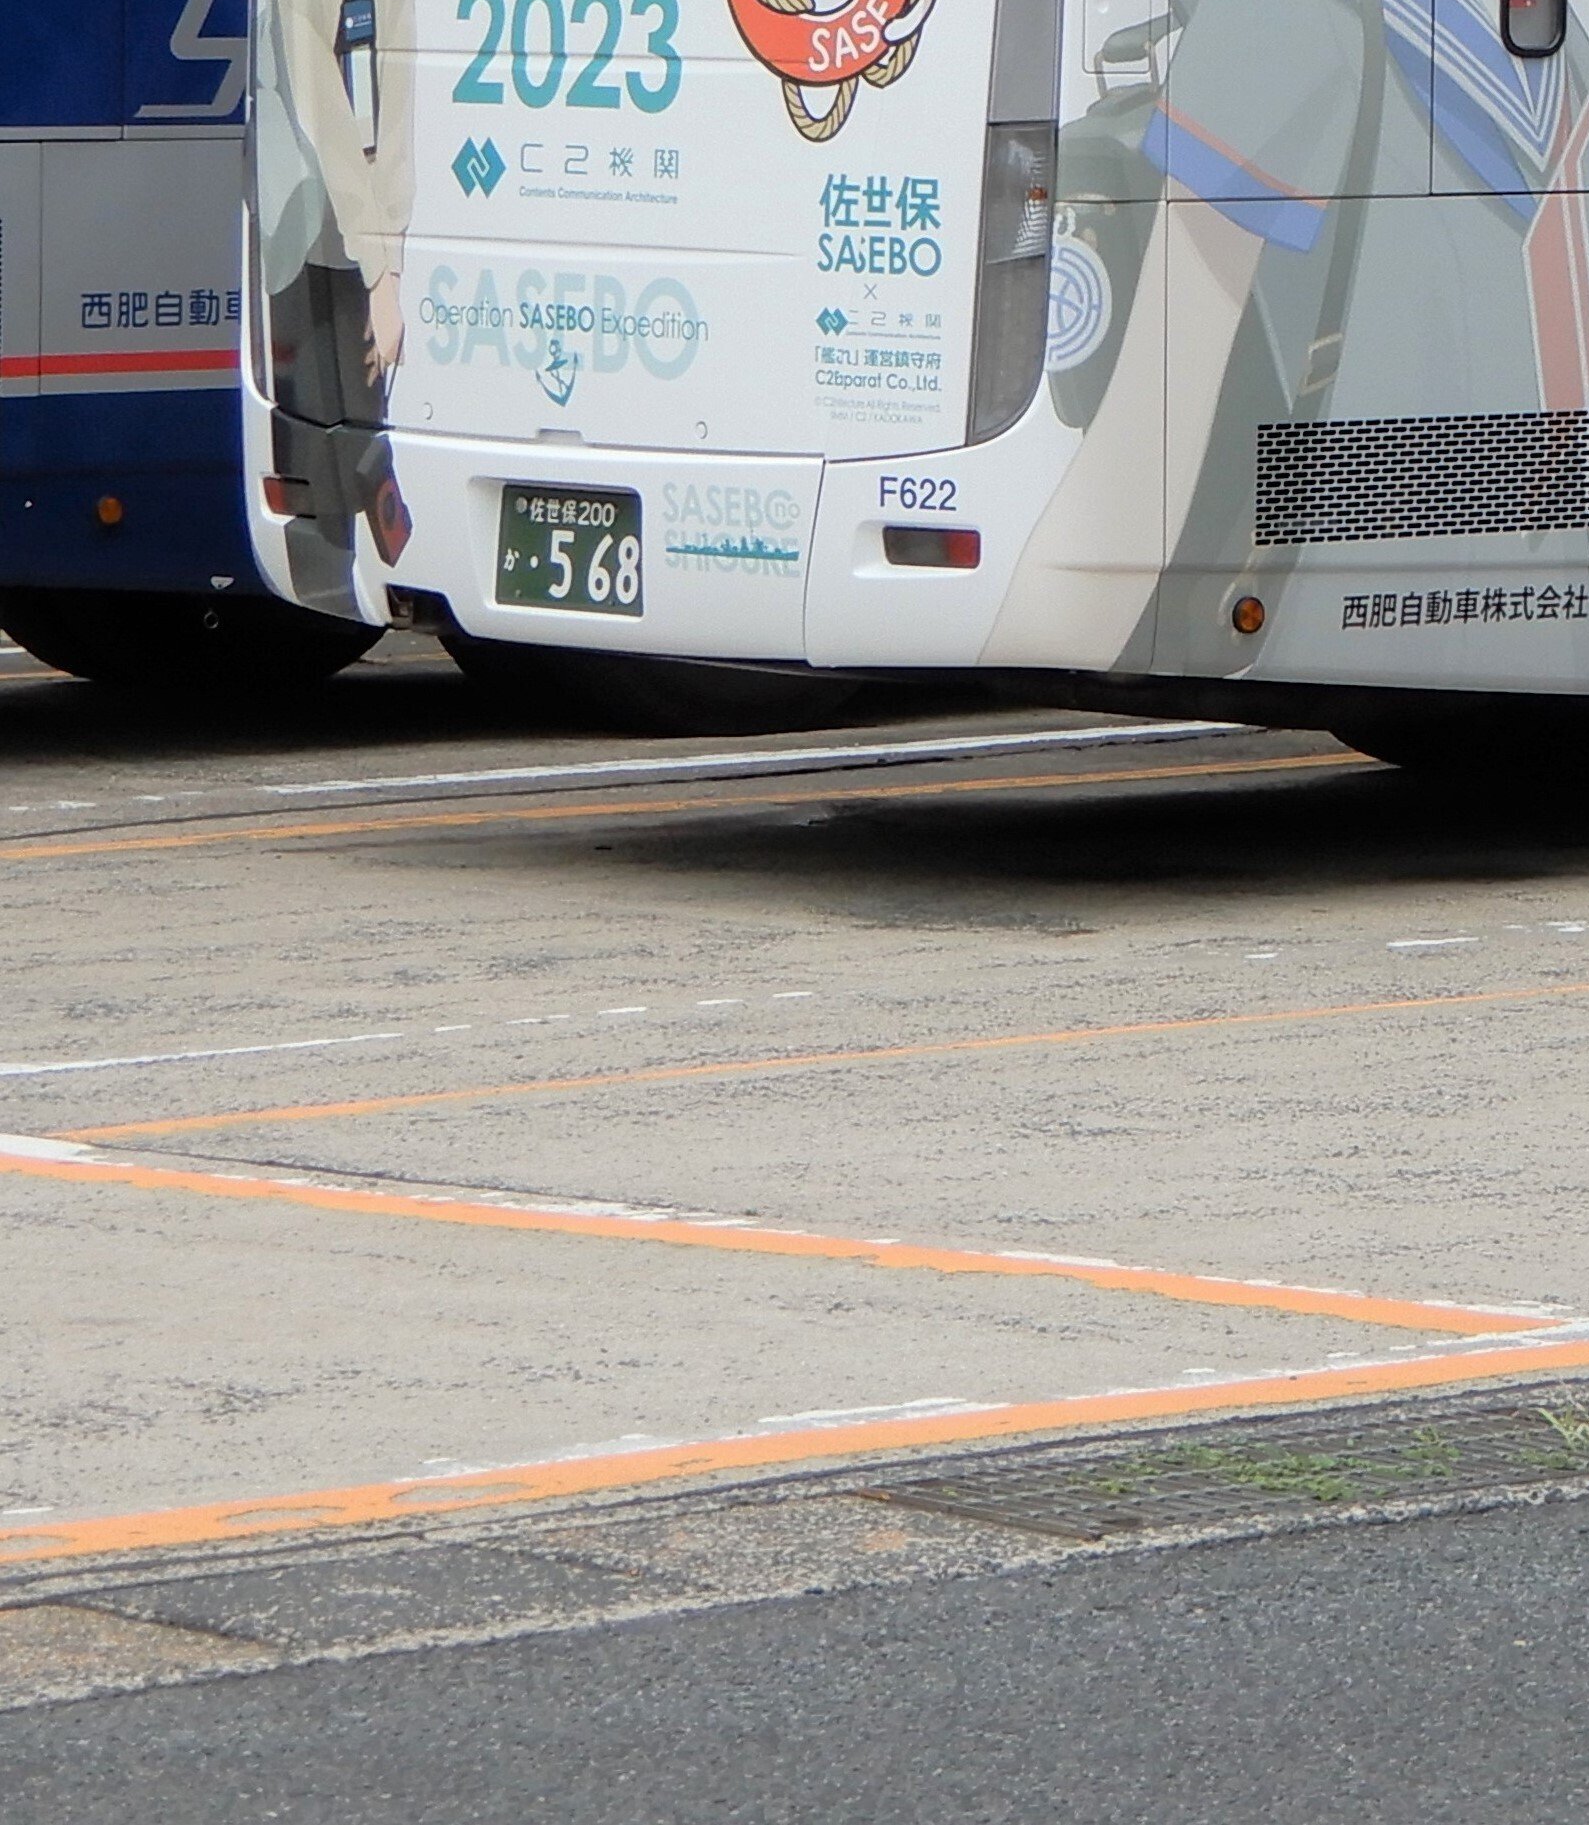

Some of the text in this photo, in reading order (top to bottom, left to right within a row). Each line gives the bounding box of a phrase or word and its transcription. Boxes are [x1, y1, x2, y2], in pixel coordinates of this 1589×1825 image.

[819, 173, 942, 231] 佐世保
[419, 297, 709, 341] Operation SASEBO Expedition
[426, 264, 700, 381] SASEBO
[879, 476, 958, 512] F622
[1341, 584, 1589, 630] 西肥自動車株式会社
